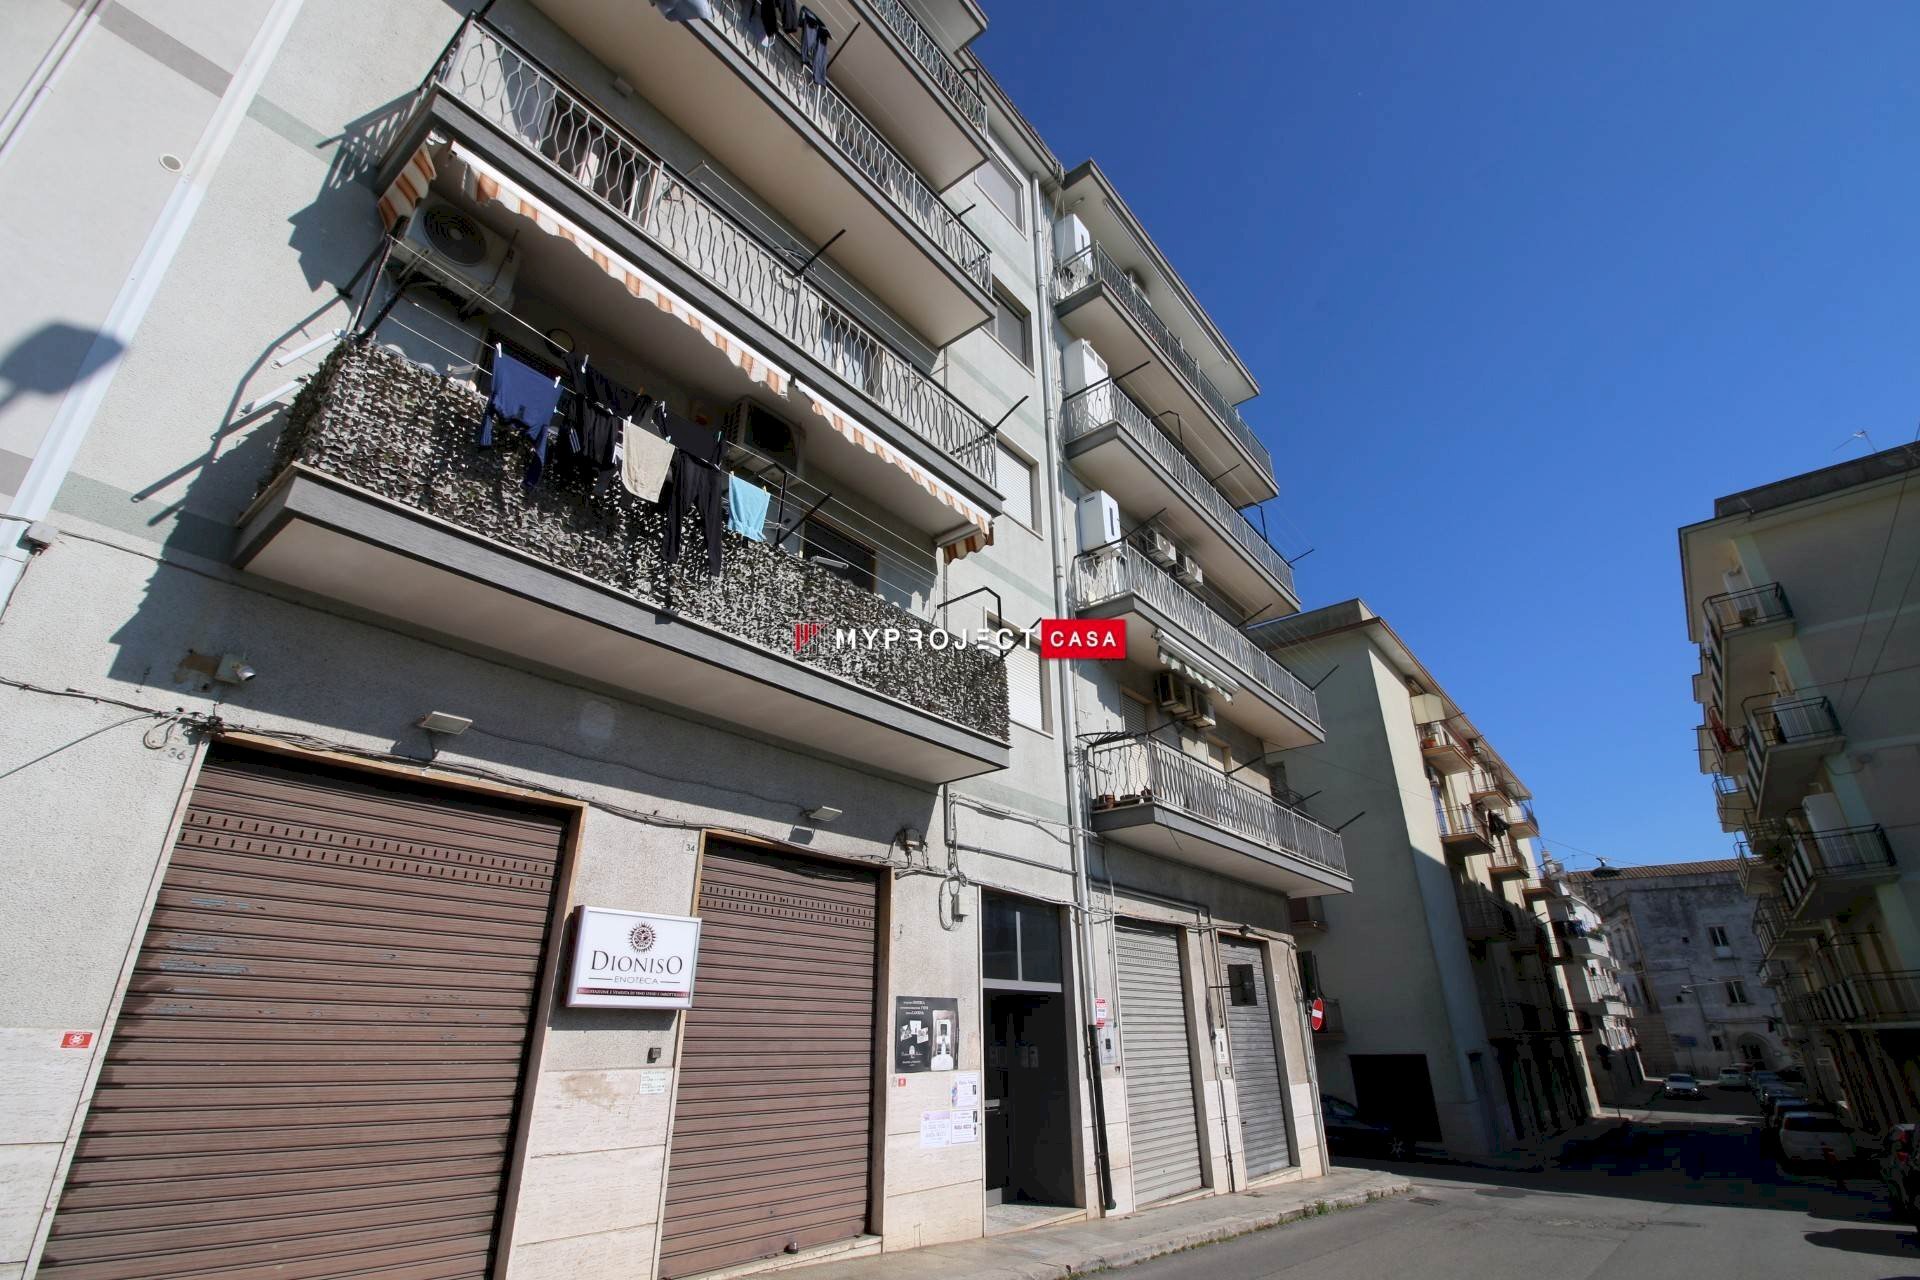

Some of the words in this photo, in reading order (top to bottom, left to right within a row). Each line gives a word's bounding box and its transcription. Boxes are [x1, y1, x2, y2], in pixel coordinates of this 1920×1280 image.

[168, 747, 186, 760] 36
[686, 843, 695, 852] 34
[591, 950, 683, 975] DIONISO
[614, 976, 659, 985] ENOTECA
